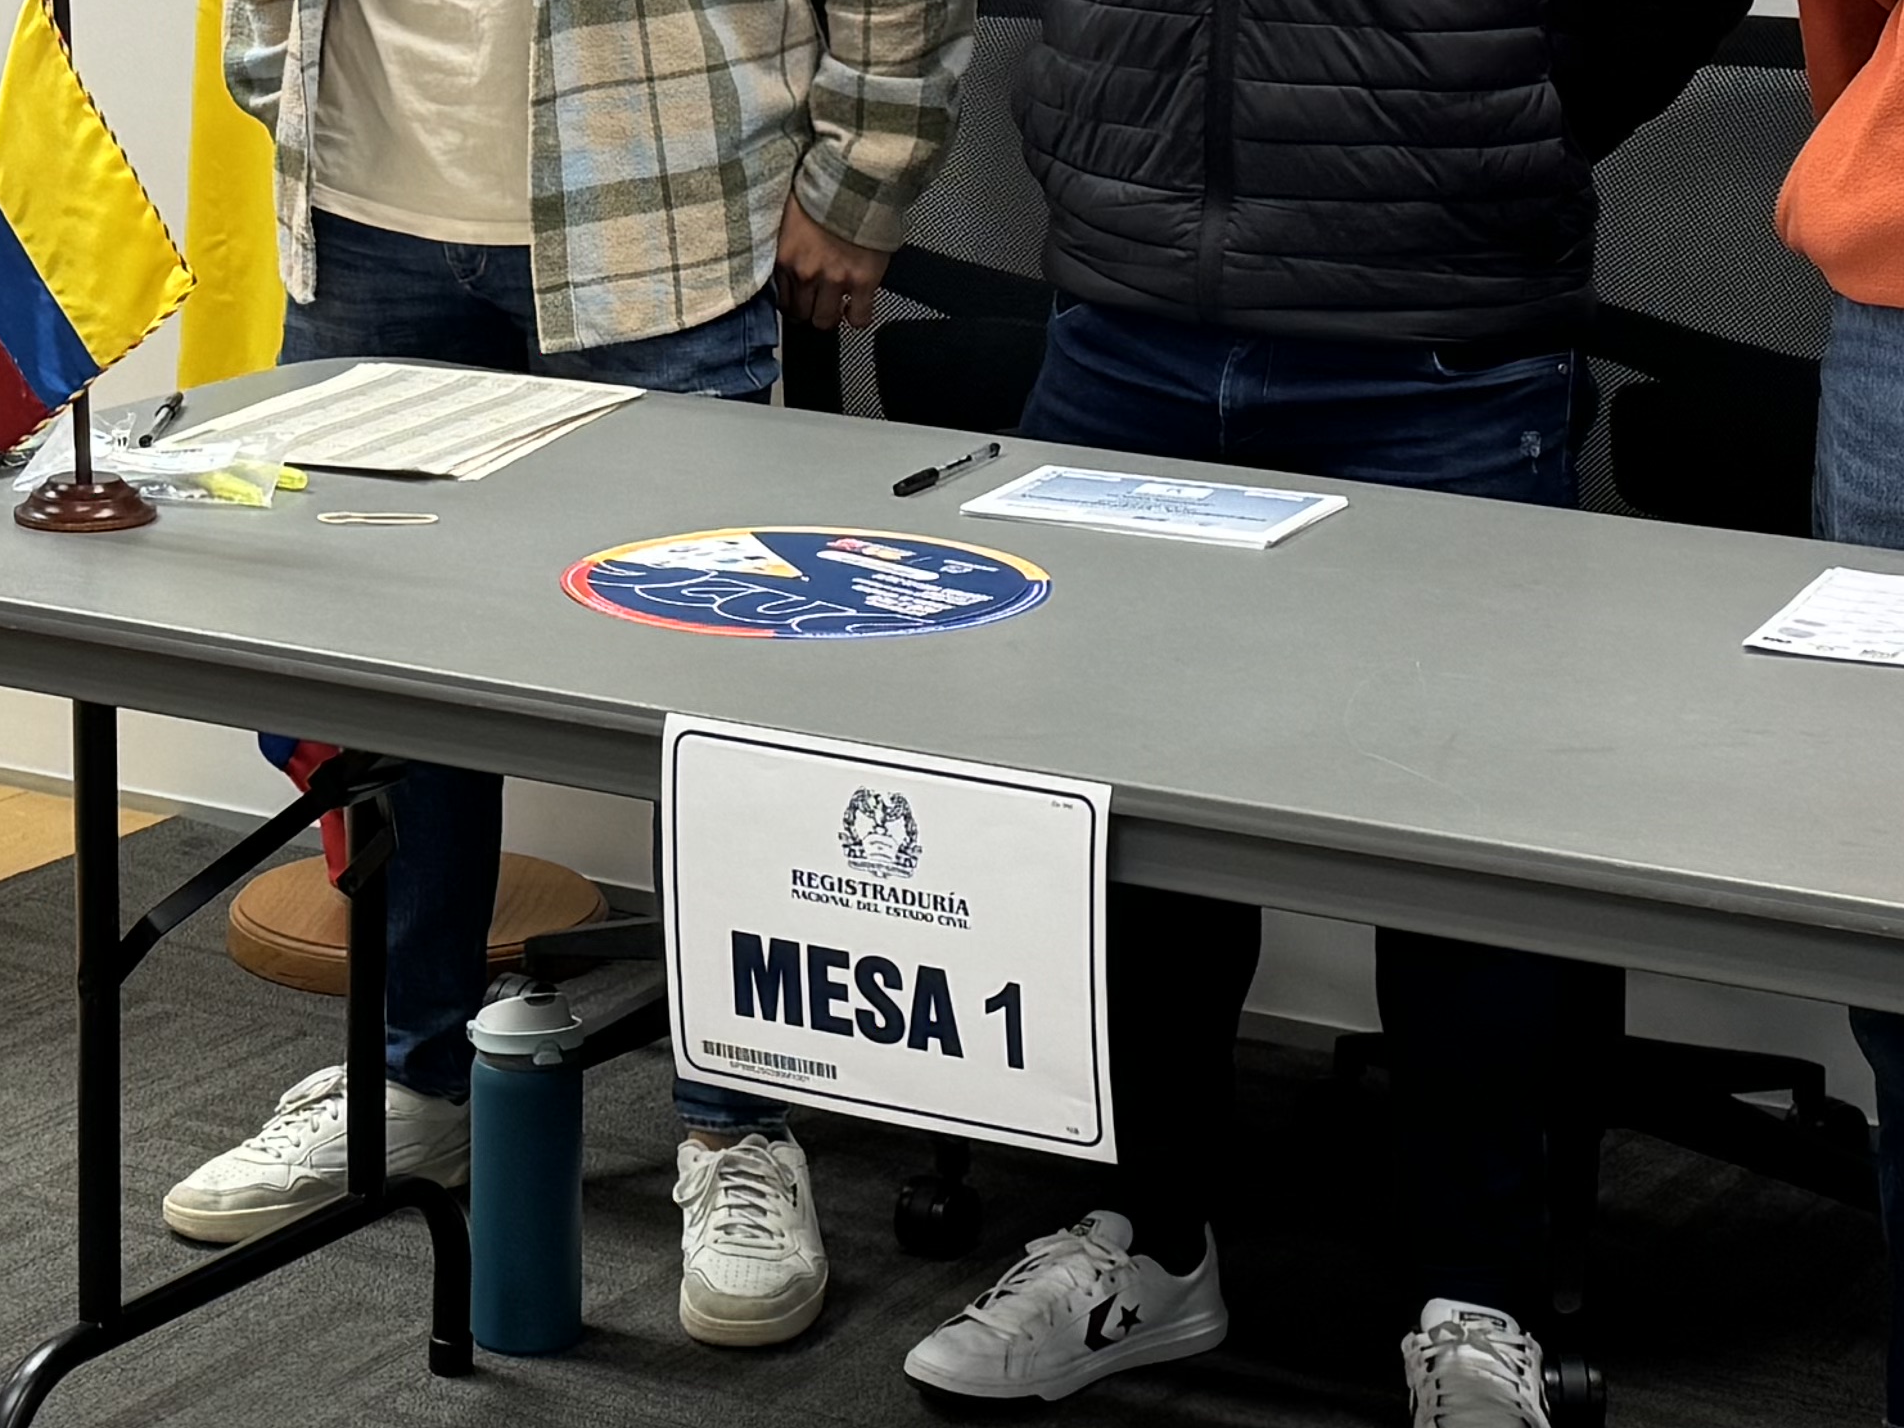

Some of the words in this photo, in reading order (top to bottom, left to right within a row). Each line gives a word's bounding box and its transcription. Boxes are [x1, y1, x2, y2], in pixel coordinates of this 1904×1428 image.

[791, 869, 970, 918] REGISTRADURÍA
[791, 888, 852, 909] NACIONAL
[857, 901, 882, 914] DEL
[886, 905, 934, 924] ESTADO
[937, 914, 972, 930] CIVIL
[731, 930, 964, 1059] MESA
[985, 981, 1024, 1070] 1
